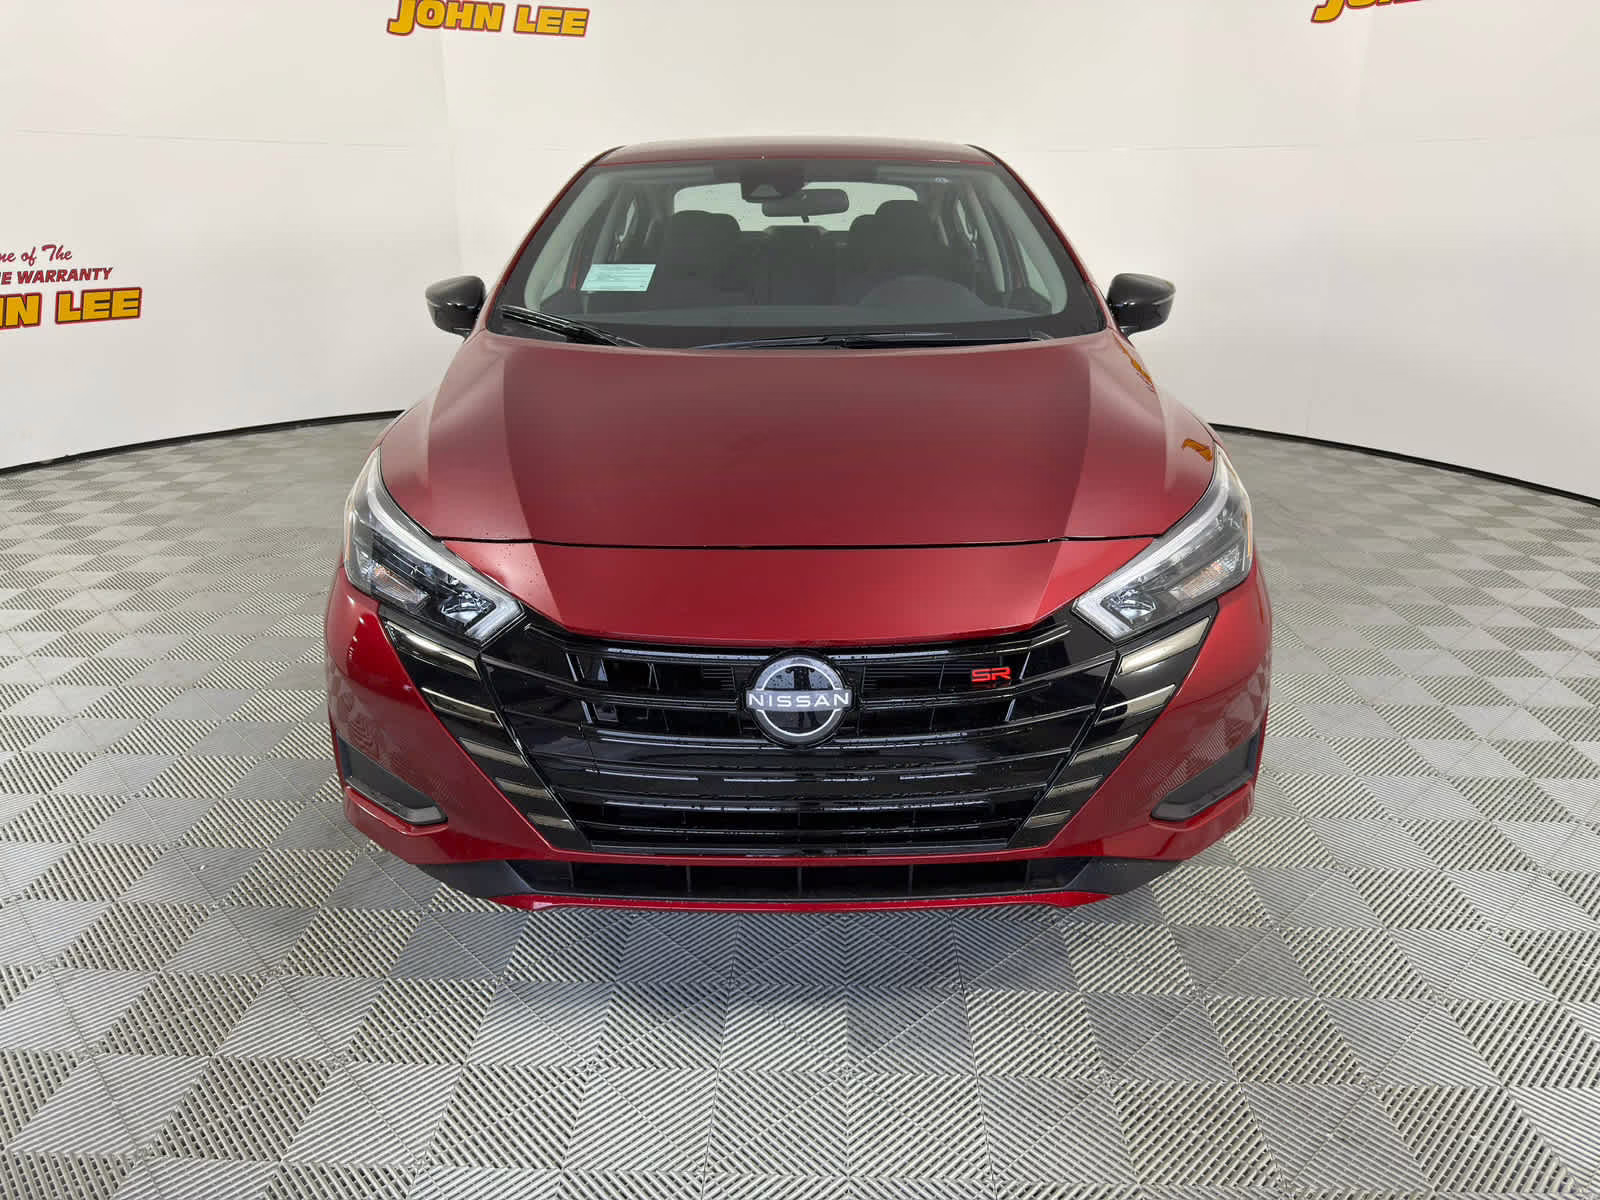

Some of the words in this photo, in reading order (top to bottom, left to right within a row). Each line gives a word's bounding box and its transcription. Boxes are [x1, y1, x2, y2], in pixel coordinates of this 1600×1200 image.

[387, 0, 505, 36] JOHN
[513, 4, 590, 37] LEE
[20, 246, 37, 267] of
[41, 244, 73, 261] The
[0, 271, 12, 285] E
[17, 267, 114, 284] WARRANTY
[0, 292, 42, 330] N
[55, 287, 142, 324] LEE
[972, 667, 1011, 682] SR
[748, 692, 849, 707] NISSAN
